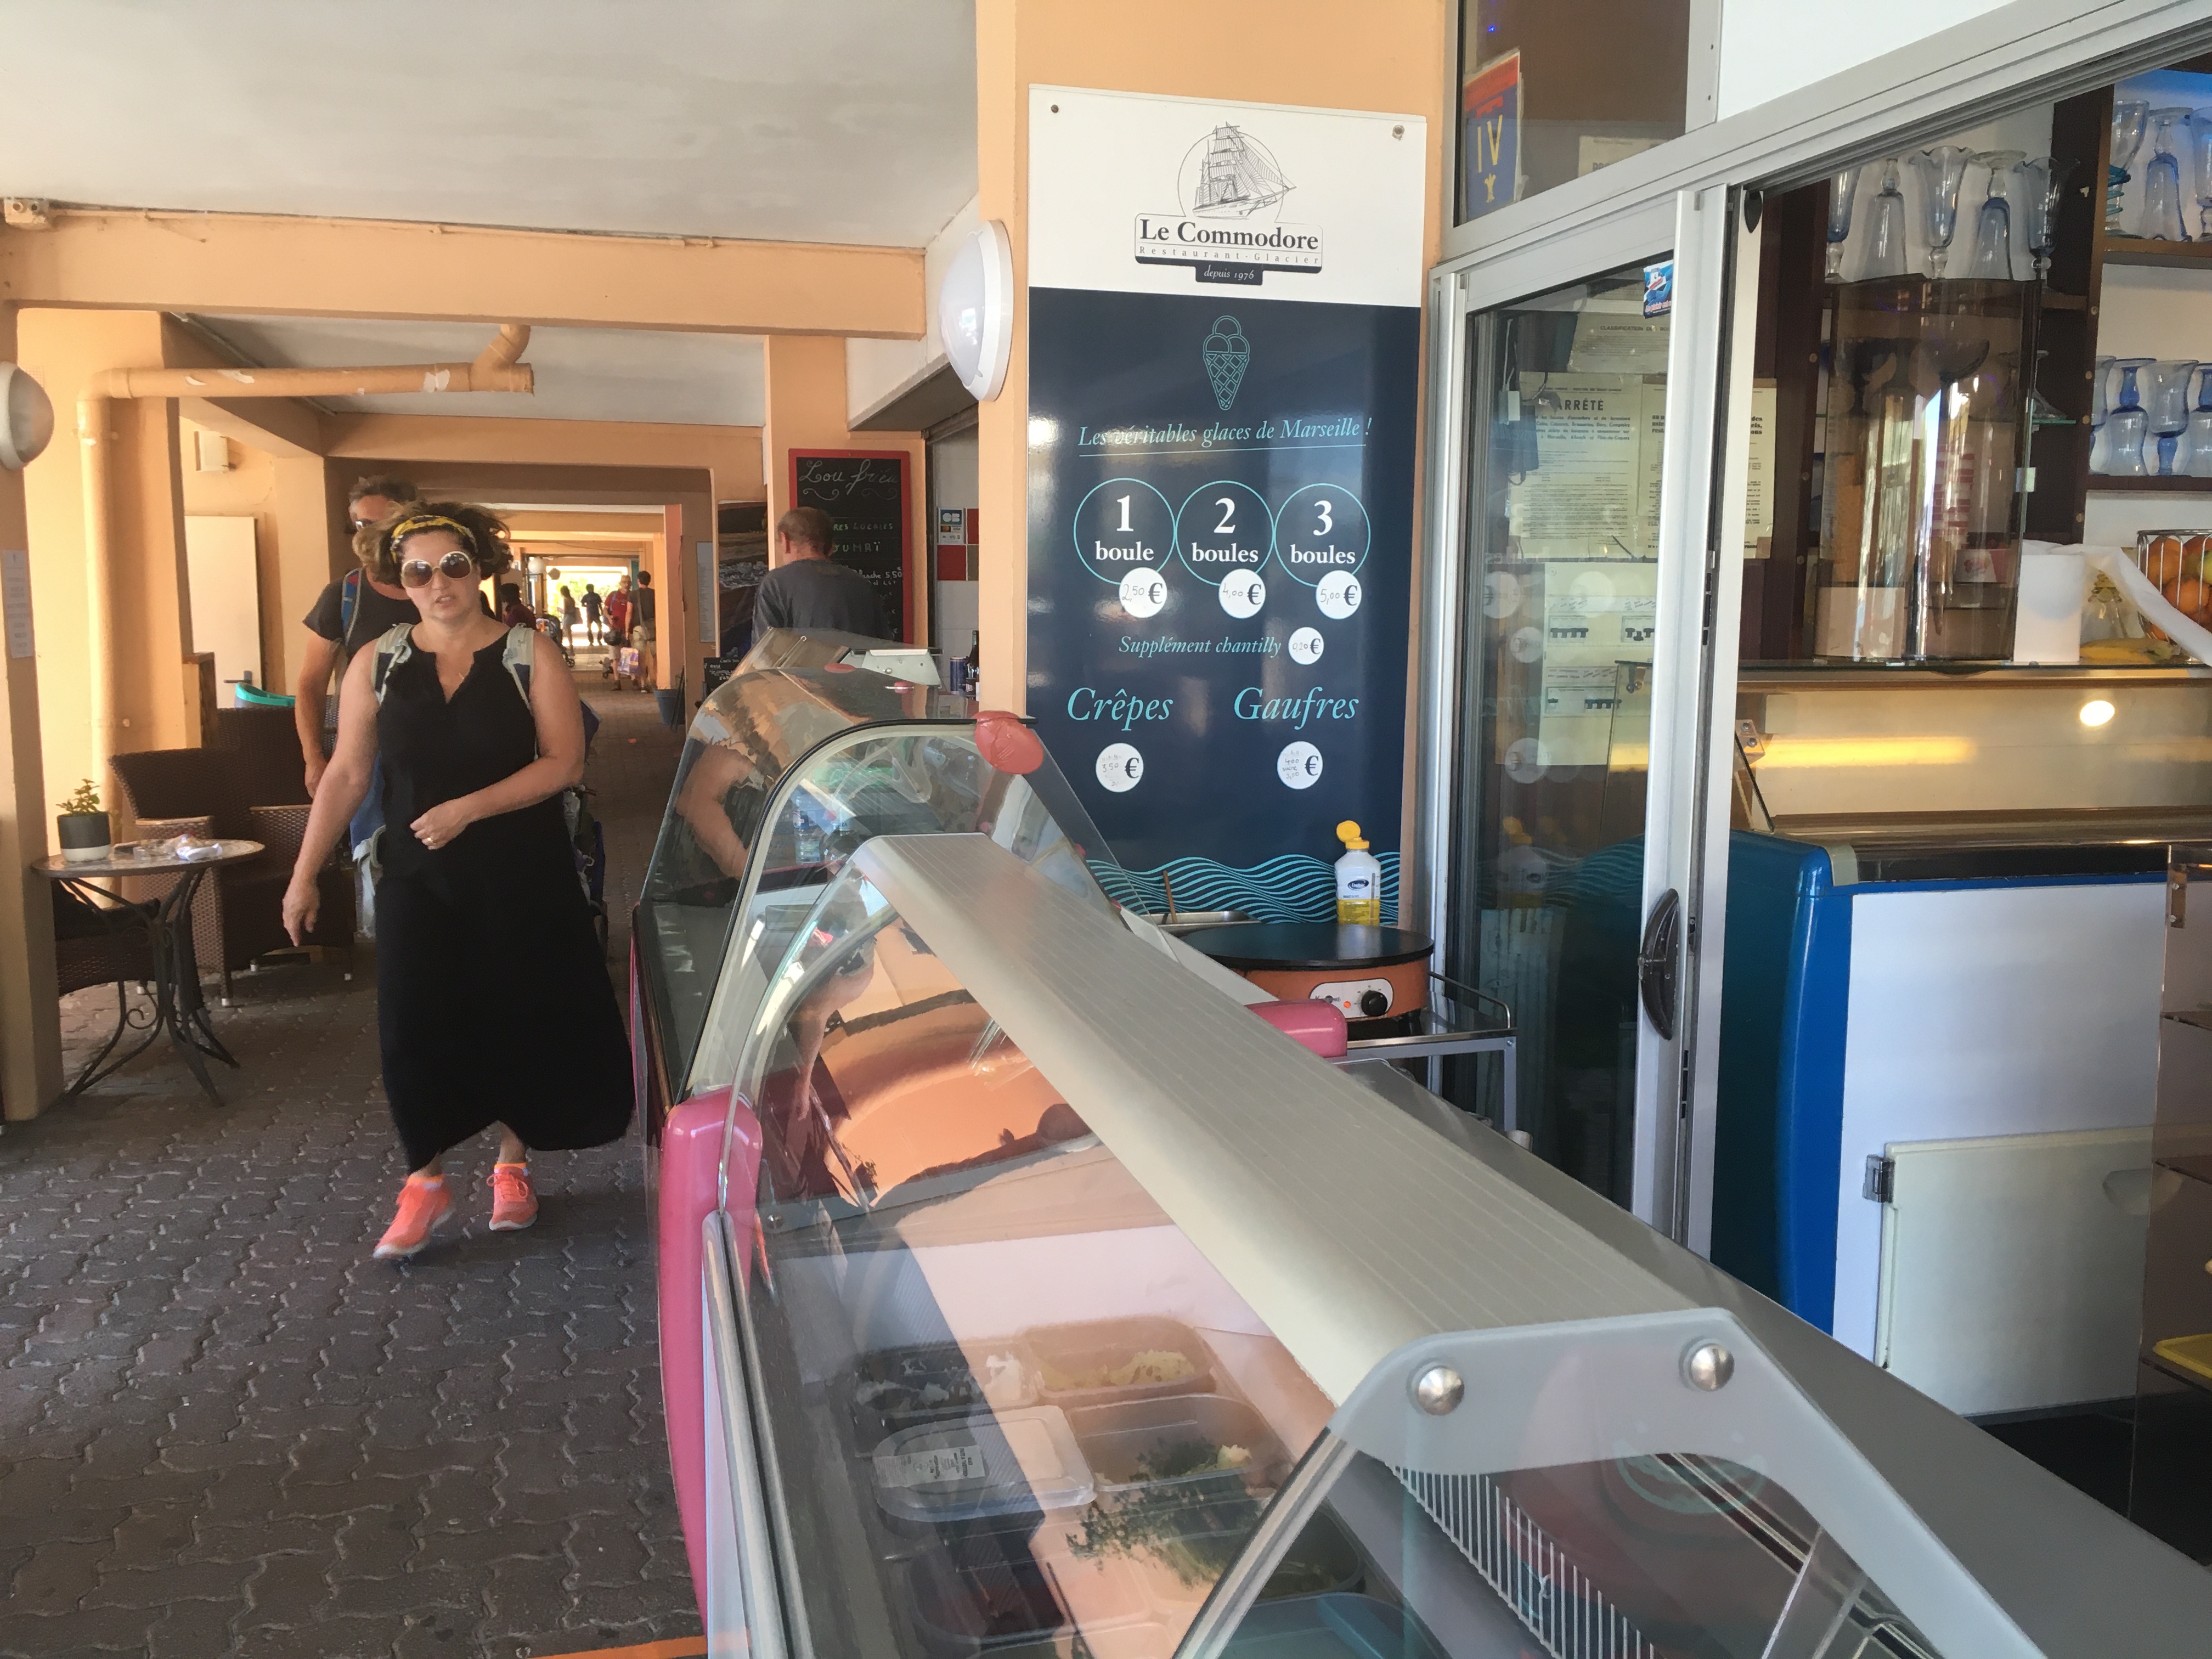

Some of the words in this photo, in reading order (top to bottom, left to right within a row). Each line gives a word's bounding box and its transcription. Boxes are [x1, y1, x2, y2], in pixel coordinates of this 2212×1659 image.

[1140, 219, 1169, 241] Le
[1177, 221, 1319, 250] Commodore
[1204, 264, 1231, 279] depuis
[1234, 269, 1254, 280] 1976
[1078, 426, 1107, 446] Les
[1115, 423, 1197, 444] véritables
[1201, 422, 1251, 448] glaces
[1256, 421, 1274, 439] de
[1280, 417, 1360, 438] Marseille
[799, 460, 845, 483] Lou
[1116, 495, 1134, 532] 1
[1214, 498, 1236, 534] 2
[1313, 500, 1333, 536] 3
[1094, 541, 1154, 561] boule
[1191, 543, 1259, 563] boules
[1290, 544, 1356, 565] boules
[1148, 582, 1163, 604] €
[1246, 583, 1262, 605] €
[1320, 589, 1340, 605] 5,00
[1343, 585, 1358, 606] €
[1119, 636, 1211, 658] Supplément
[1215, 636, 1282, 658] chantilly
[1310, 638, 1321, 654] €
[1067, 687, 1173, 731] Crêpes
[1234, 686, 1359, 730] Gaufres
[1124, 757, 1139, 778] €
[1305, 755, 1319, 776] €
